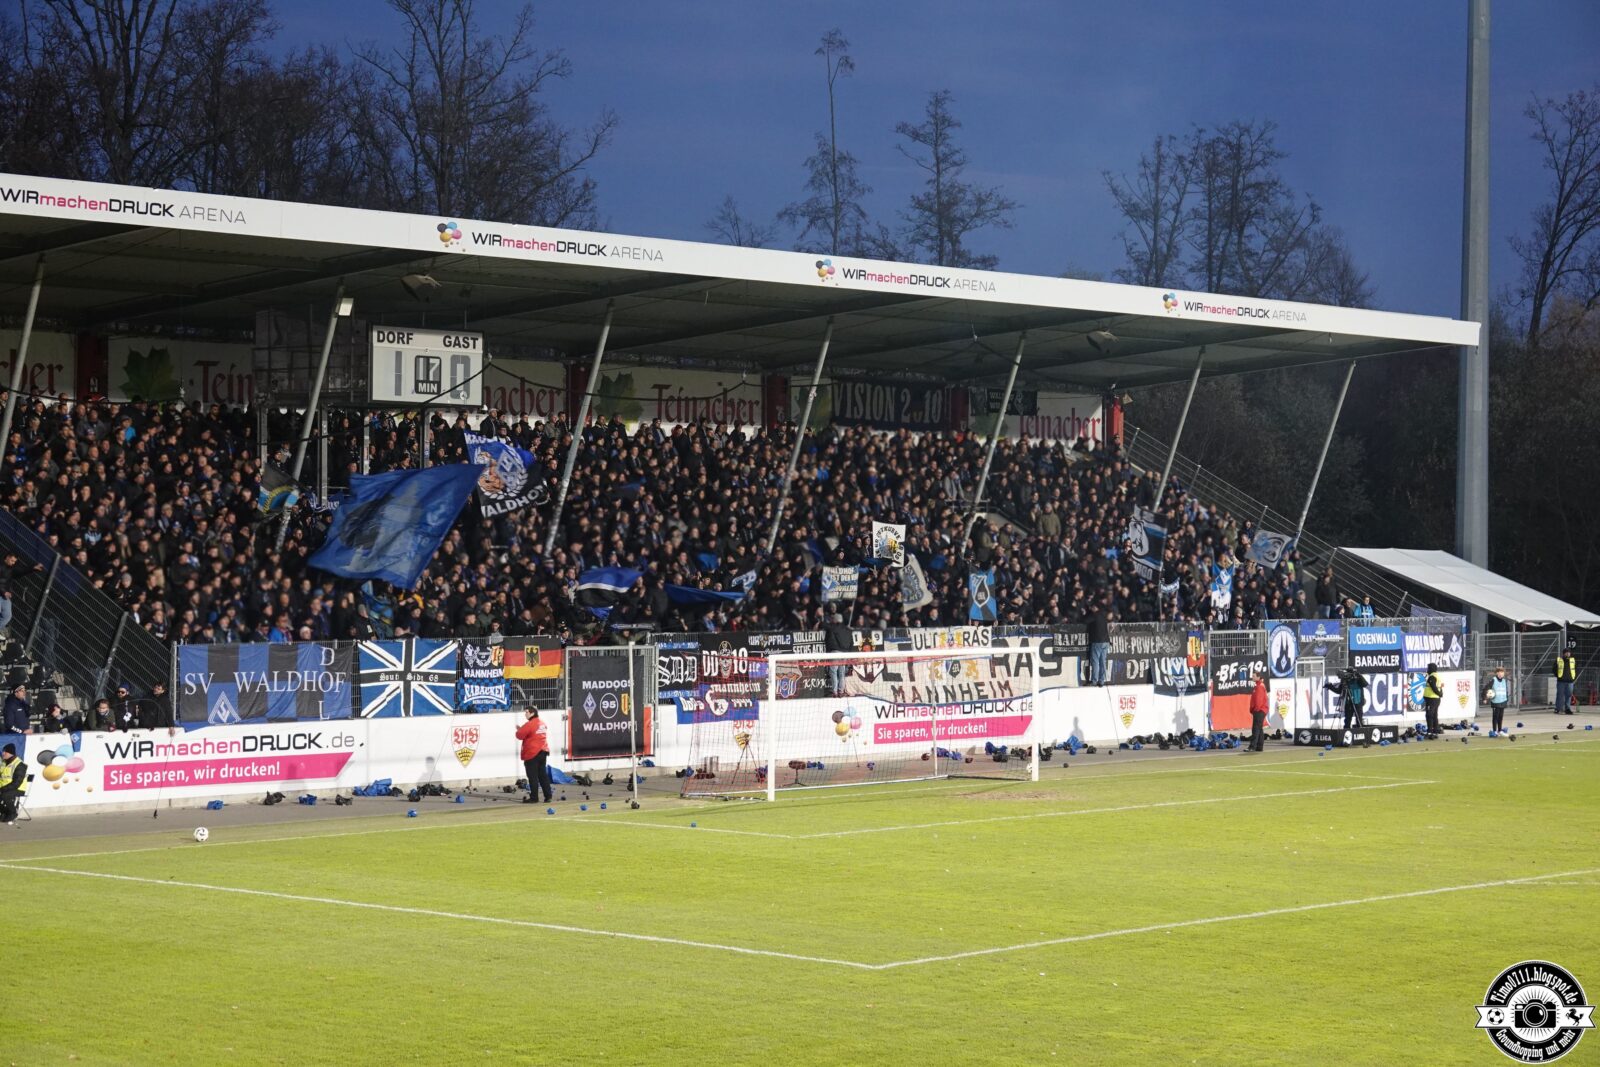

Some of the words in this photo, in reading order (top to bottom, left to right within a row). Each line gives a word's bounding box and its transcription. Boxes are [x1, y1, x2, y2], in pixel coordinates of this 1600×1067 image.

[0, 187, 174, 218] WIRmachenDRUCK
[179, 205, 247, 225] ARENA
[472, 231, 607, 257] WIRmachenDRUCK
[610, 245, 664, 262] ARENA
[842, 267, 950, 288] WIRmachenDRUCK
[953, 278, 996, 292] ARENA
[1184, 301, 1270, 319] WIRmachenDRUCK
[1272, 309, 1307, 322] ARENA
[376, 330, 413, 345] DORF
[443, 335, 478, 349] GAST
[419, 357, 440, 382] 17
[418, 382, 438, 393] MIN
[833, 382, 896, 423] VISION
[1356, 632, 1397, 646] ODENWALD
[1405, 634, 1445, 651] WALDHOF
[1354, 654, 1400, 667] BARACKLER
[184, 672, 215, 696] SV
[233, 670, 347, 694] WALDHOF
[891, 680, 1014, 704] MANNHEIM
[601, 700, 617, 709] 95
[878, 728, 893, 739] Sie
[895, 727, 929, 740] sparen,
[950, 721, 988, 735] drucken!
[110, 769, 131, 785] Sie
[135, 767, 189, 785] sparen,
[193, 765, 217, 779] wir
[219, 760, 281, 778] drucken!
